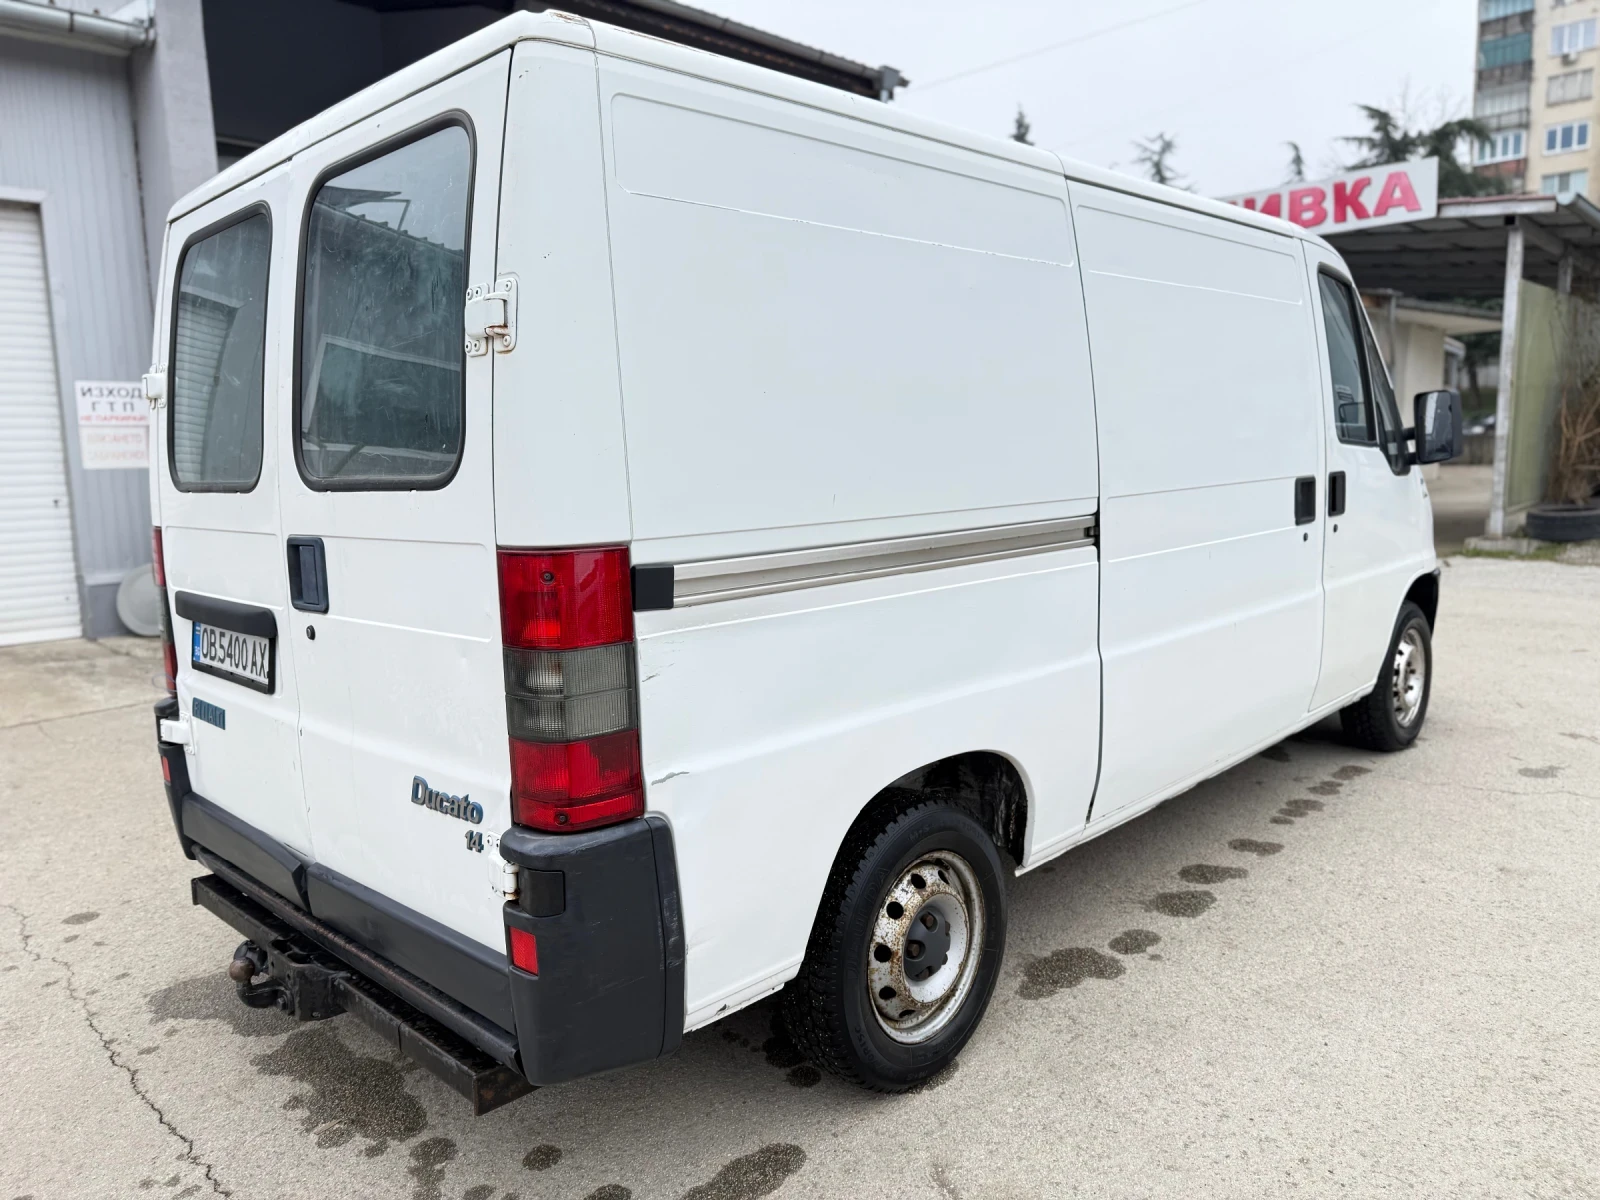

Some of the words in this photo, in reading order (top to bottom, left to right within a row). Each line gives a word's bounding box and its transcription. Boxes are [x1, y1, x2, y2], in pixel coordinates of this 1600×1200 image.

[1228, 171, 1422, 229] ИВКА
[81, 386, 143, 400] ИЗХОД
[192, 697, 225, 730] FIAT
[411, 775, 484, 824] Ducato
[465, 829, 484, 853] 14
